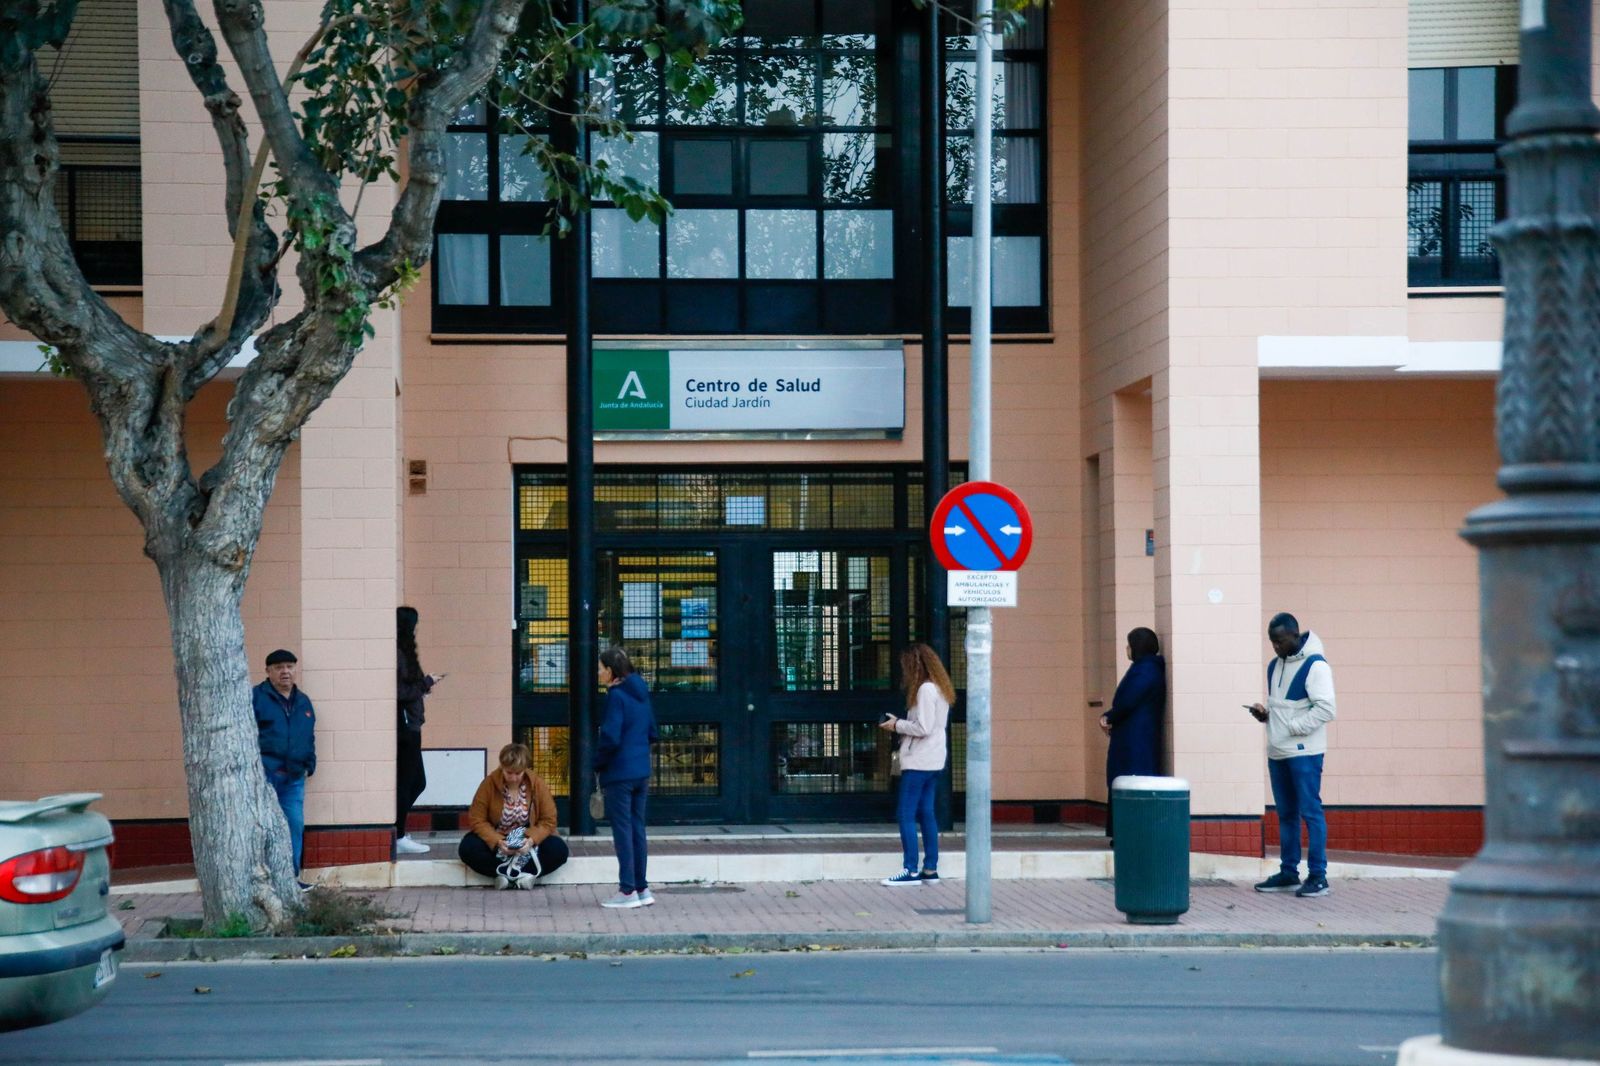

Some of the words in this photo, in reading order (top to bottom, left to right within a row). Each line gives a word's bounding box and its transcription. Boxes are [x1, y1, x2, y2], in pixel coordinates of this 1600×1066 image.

[685, 378, 741, 393] Centro
[748, 377, 768, 393] de
[775, 377, 821, 393] Salud
[599, 401, 619, 409] Junta
[620, 401, 628, 409] de
[684, 396, 729, 409] Ciudad
[732, 395, 771, 409] Jardín
